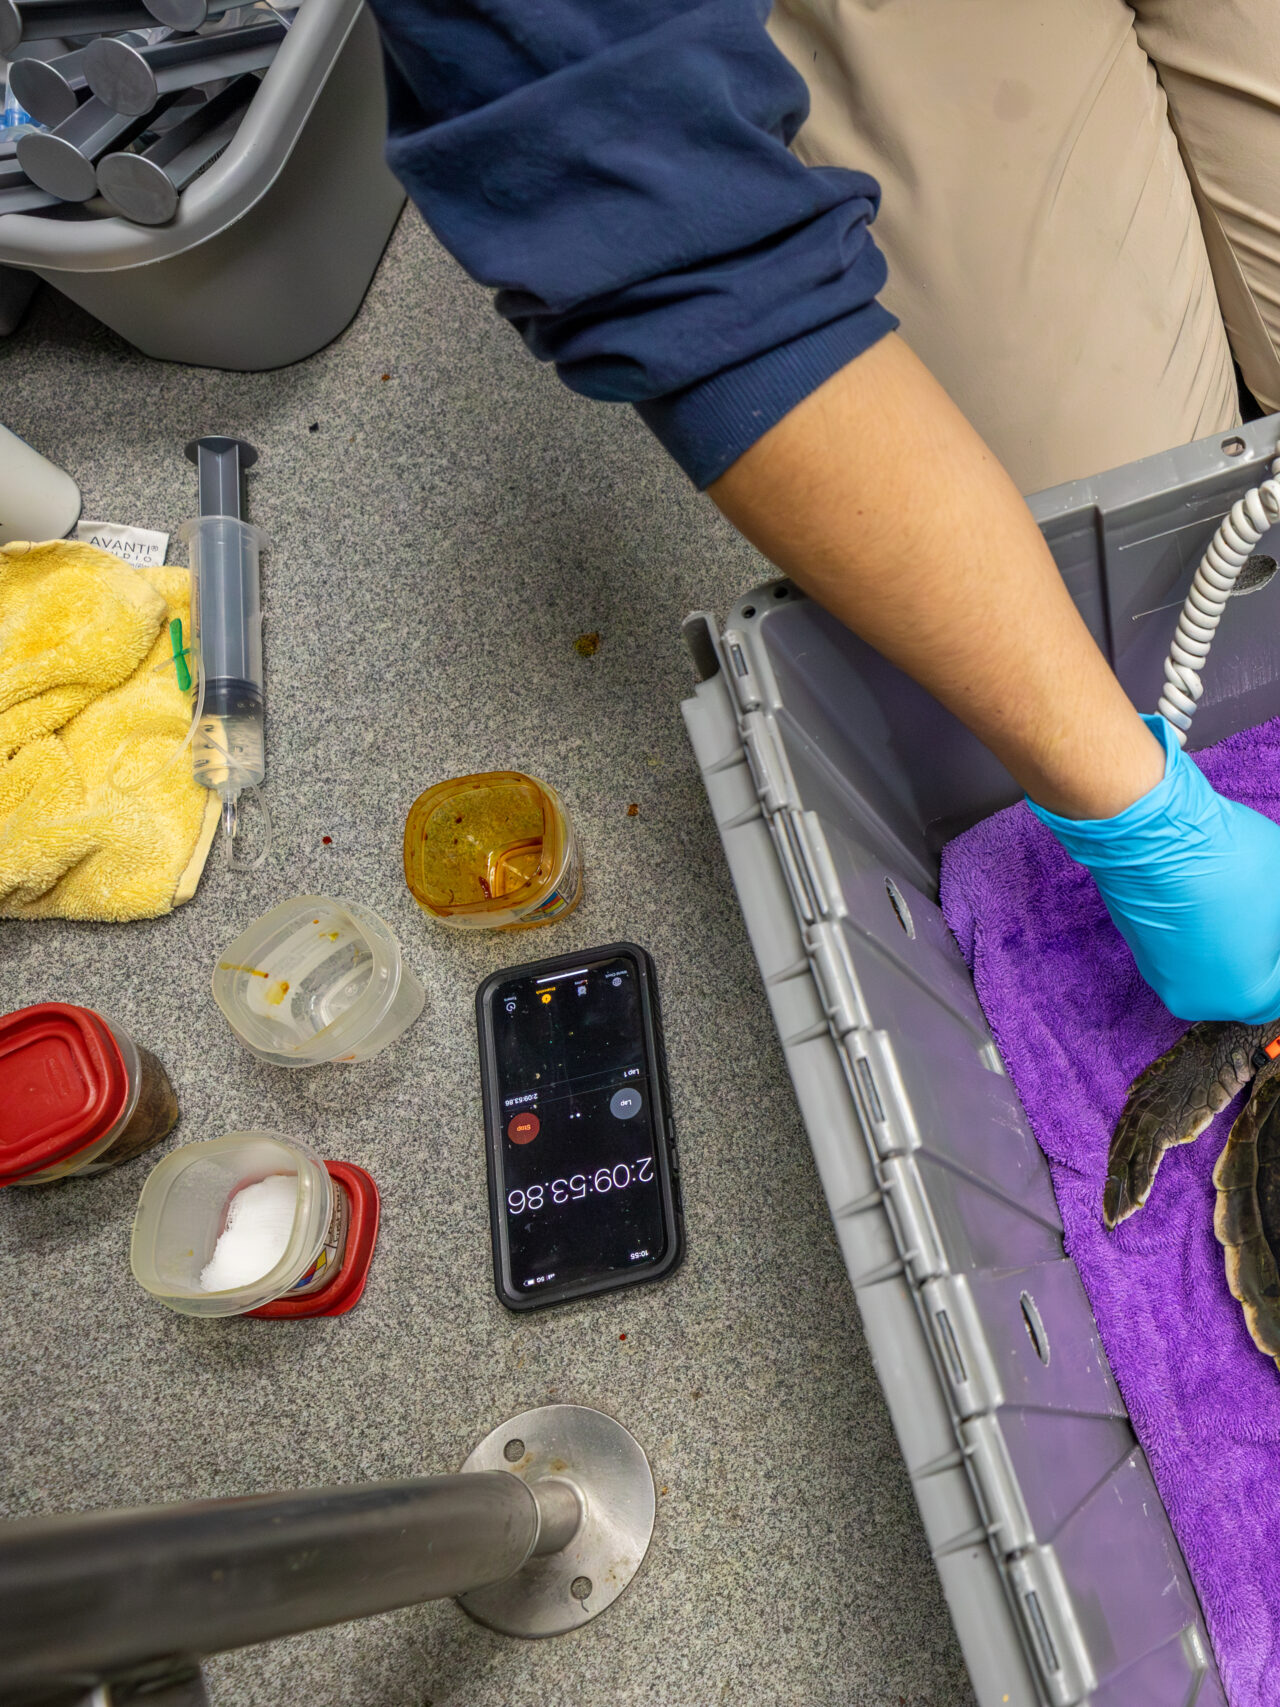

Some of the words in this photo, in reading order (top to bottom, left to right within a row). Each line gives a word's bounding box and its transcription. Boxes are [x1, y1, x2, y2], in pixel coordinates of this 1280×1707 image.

[628, 1068, 640, 1076] Lap
[620, 1099, 632, 1107] Lap
[508, 1156, 654, 1215] 2:09:53.86
[630, 1250, 649, 1260] 10:55
